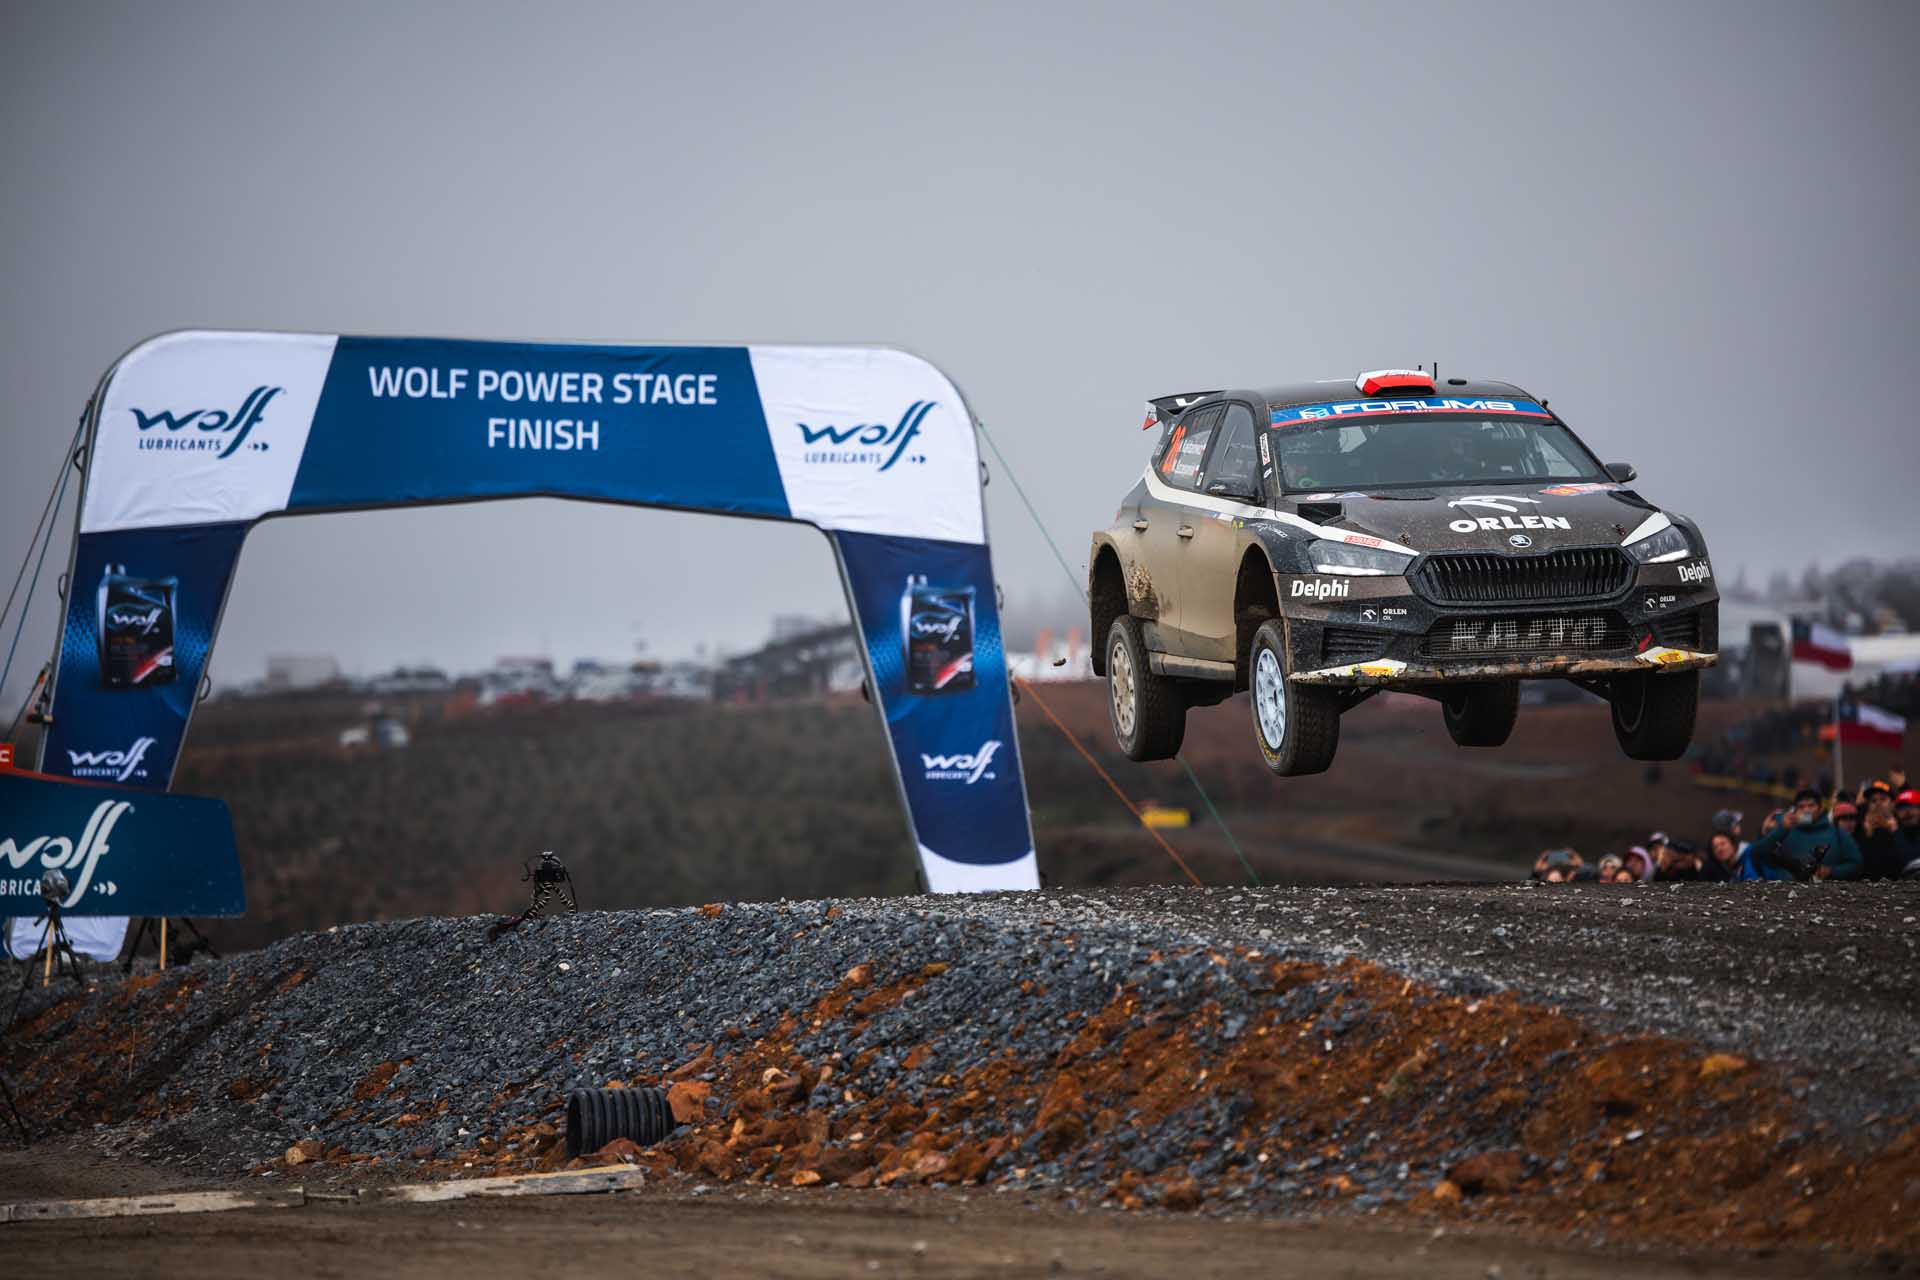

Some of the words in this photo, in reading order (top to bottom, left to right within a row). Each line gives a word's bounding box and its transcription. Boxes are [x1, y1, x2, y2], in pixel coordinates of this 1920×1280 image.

[369, 366, 468, 399] WOLF
[477, 369, 604, 403] POWER
[612, 373, 718, 405] STAGE
[139, 438, 222, 450] LUBRICANTS
[488, 417, 600, 451] FINISH
[804, 451, 882, 463] LUBRICANTS
[1449, 516, 1571, 533] ORLEN
[1677, 561, 1711, 583] Delphi
[1291, 580, 1350, 600] Delphi
